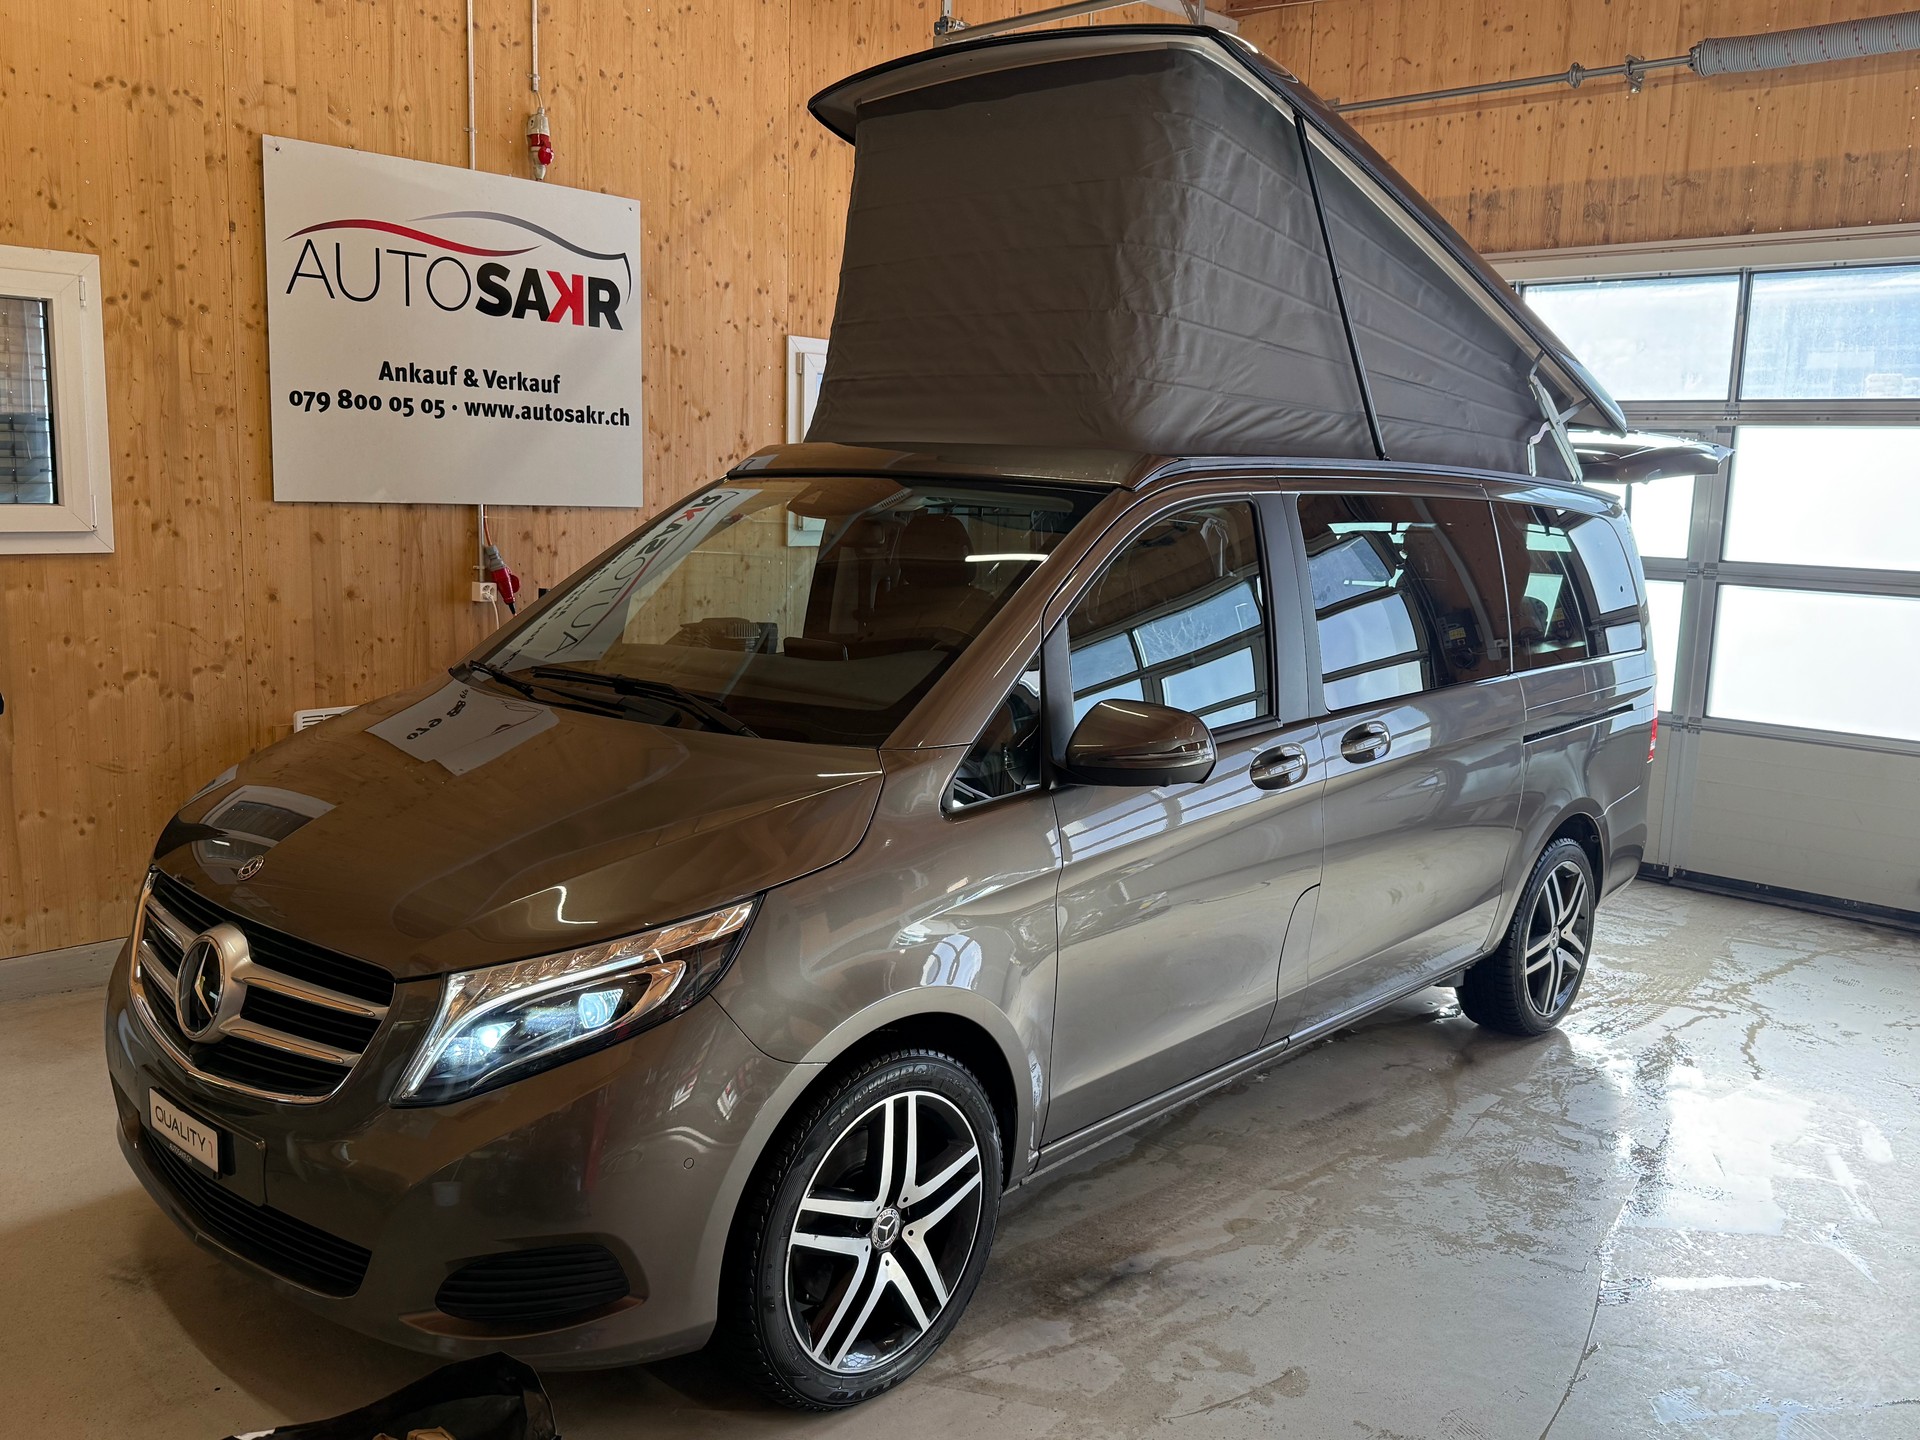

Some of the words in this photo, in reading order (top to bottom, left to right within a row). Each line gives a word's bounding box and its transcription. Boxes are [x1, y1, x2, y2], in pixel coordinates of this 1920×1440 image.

[285, 239, 624, 331] AUTOSAKR
[378, 361, 457, 386] Ankauf
[463, 368, 480, 388] &
[482, 369, 561, 394] Verkauf
[288, 390, 331, 413] 079
[337, 388, 383, 411] 800
[388, 397, 415, 419] 05
[420, 399, 446, 420] 05
[463, 401, 631, 427] www.autosakr.ch
